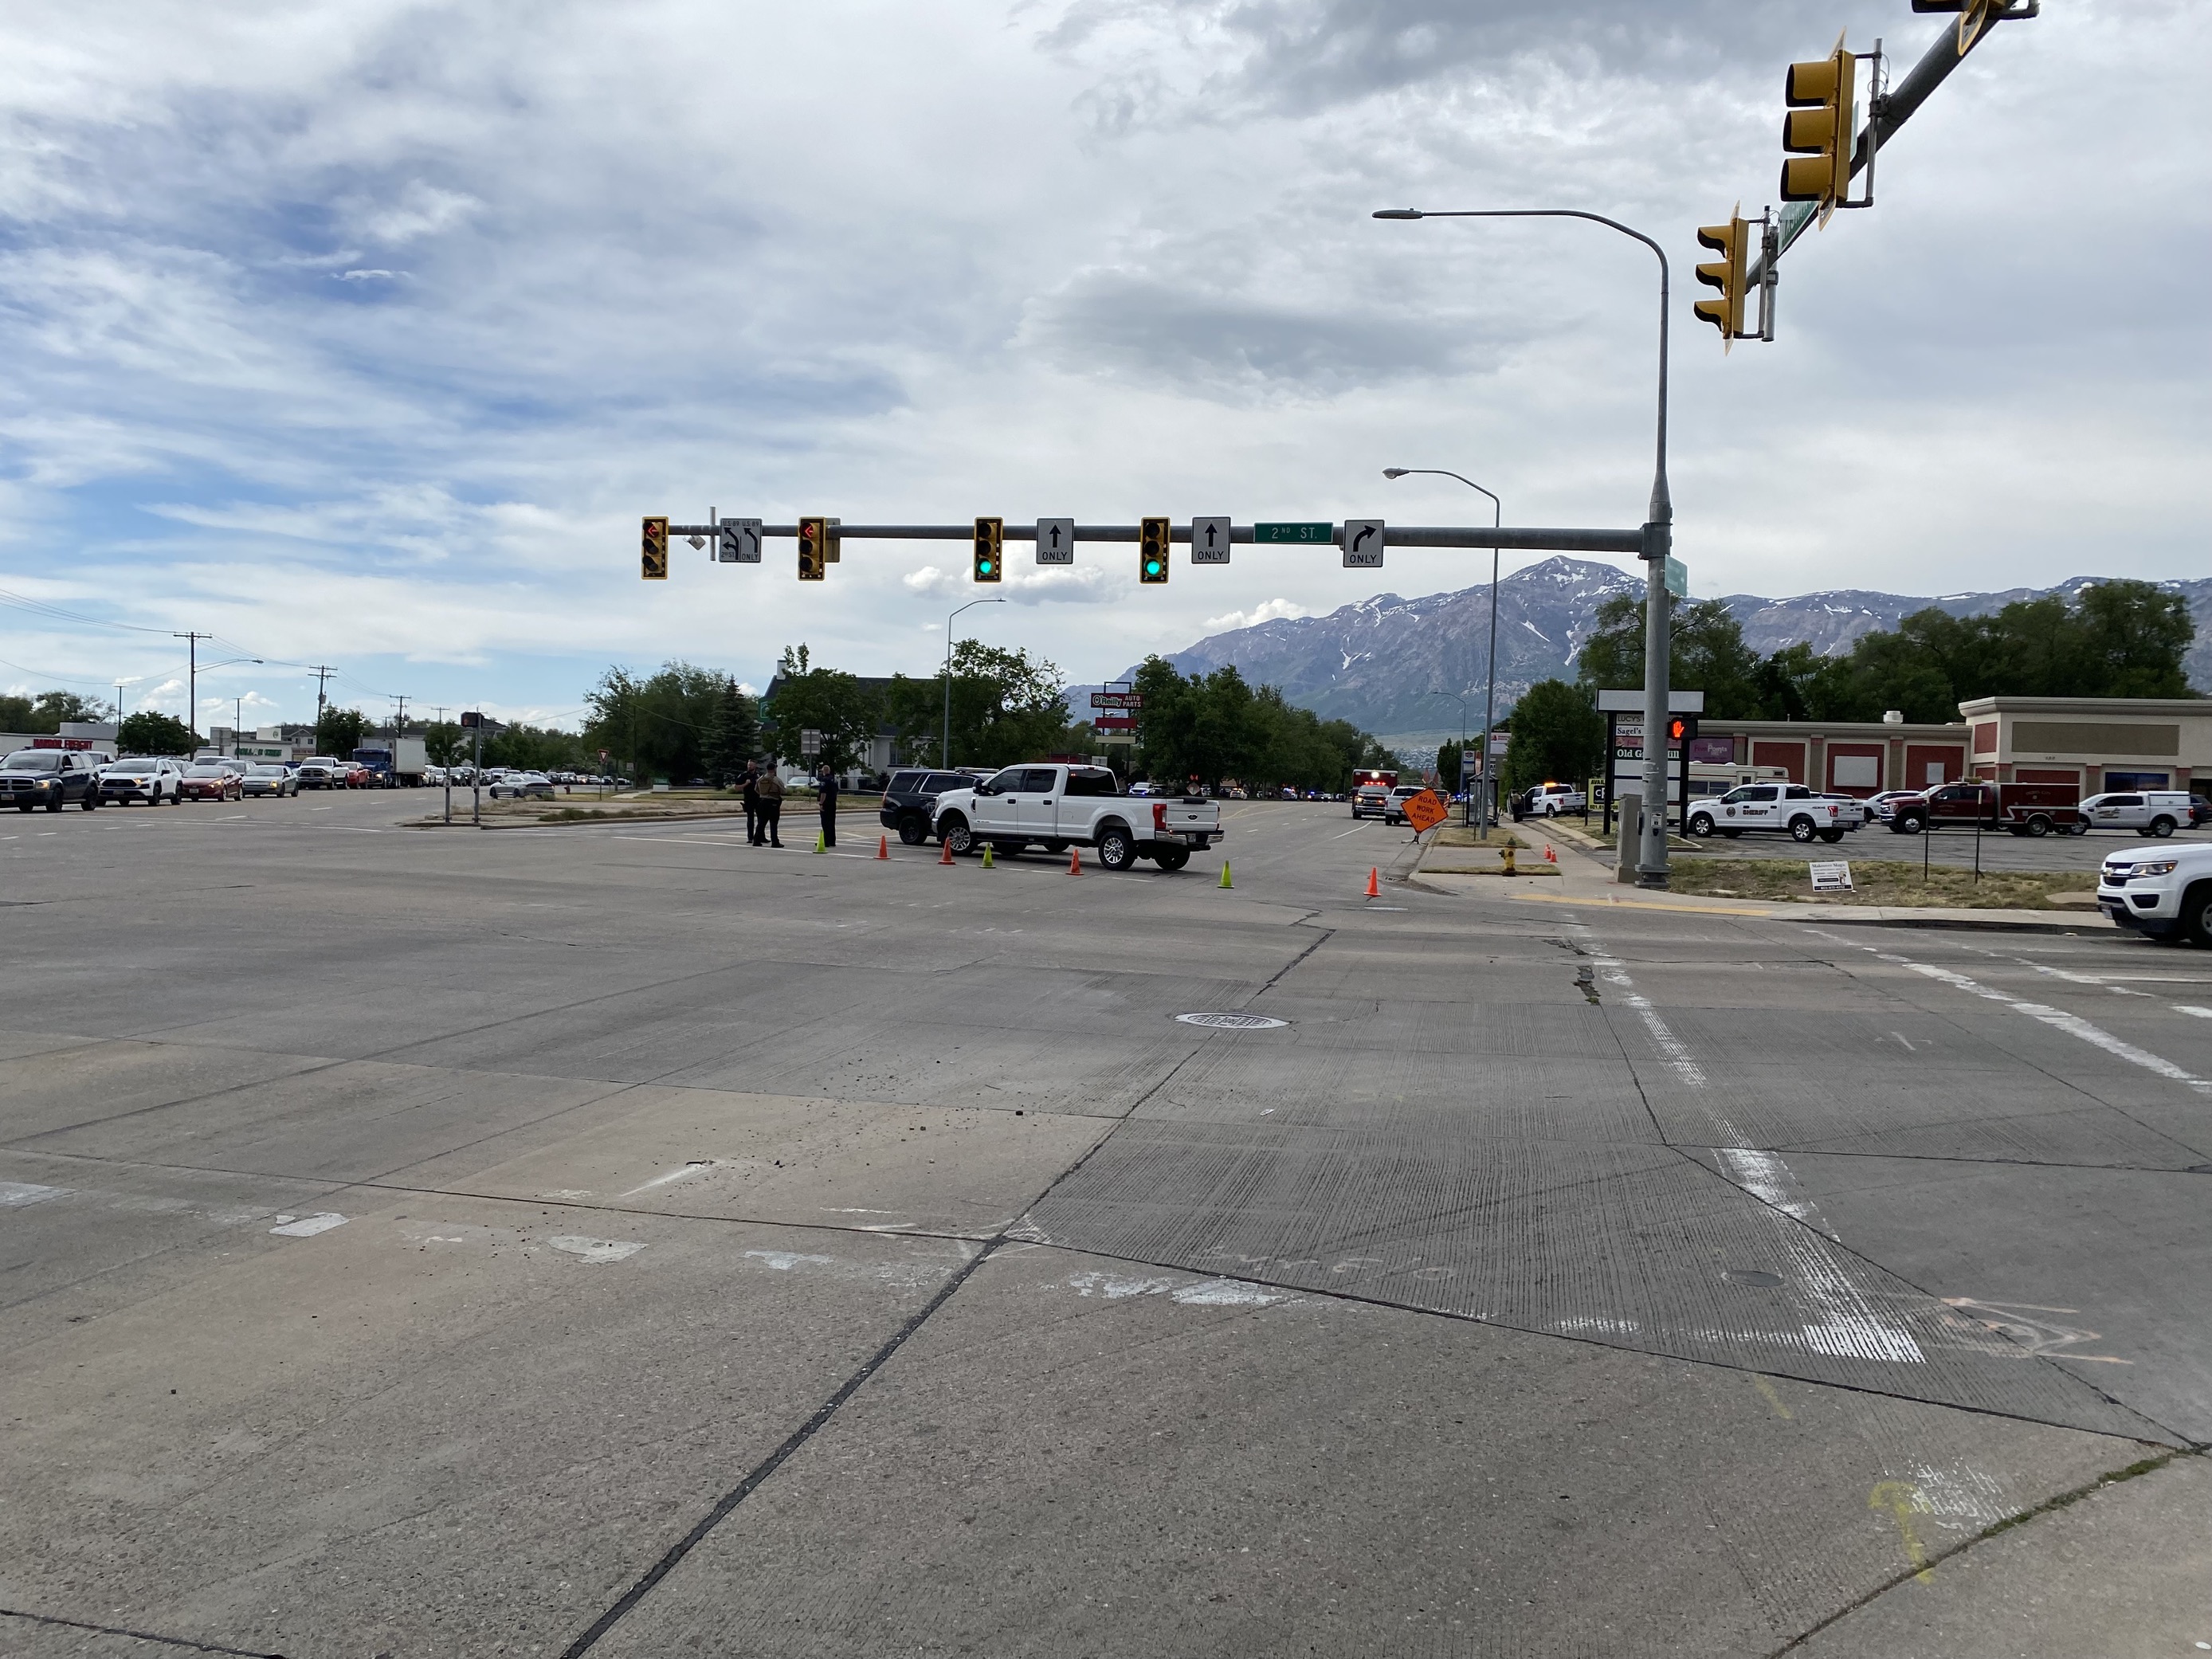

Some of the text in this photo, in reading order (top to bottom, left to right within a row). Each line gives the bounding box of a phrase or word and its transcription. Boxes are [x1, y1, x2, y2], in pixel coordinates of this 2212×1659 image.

[1272, 527, 1317, 539] 2ND ST.
[1041, 551, 1068, 560] ONLY
[1198, 551, 1224, 560] ONLY
[1349, 555, 1377, 563] ONLY
[1092, 694, 1123, 708] O'Reilly
[1617, 727, 1641, 736] Sagel's
[1617, 749, 1634, 758] Old
[1418, 796, 1437, 805] ROAD
[1416, 805, 1434, 814] WORK
[1412, 813, 1434, 822] AHEAD
